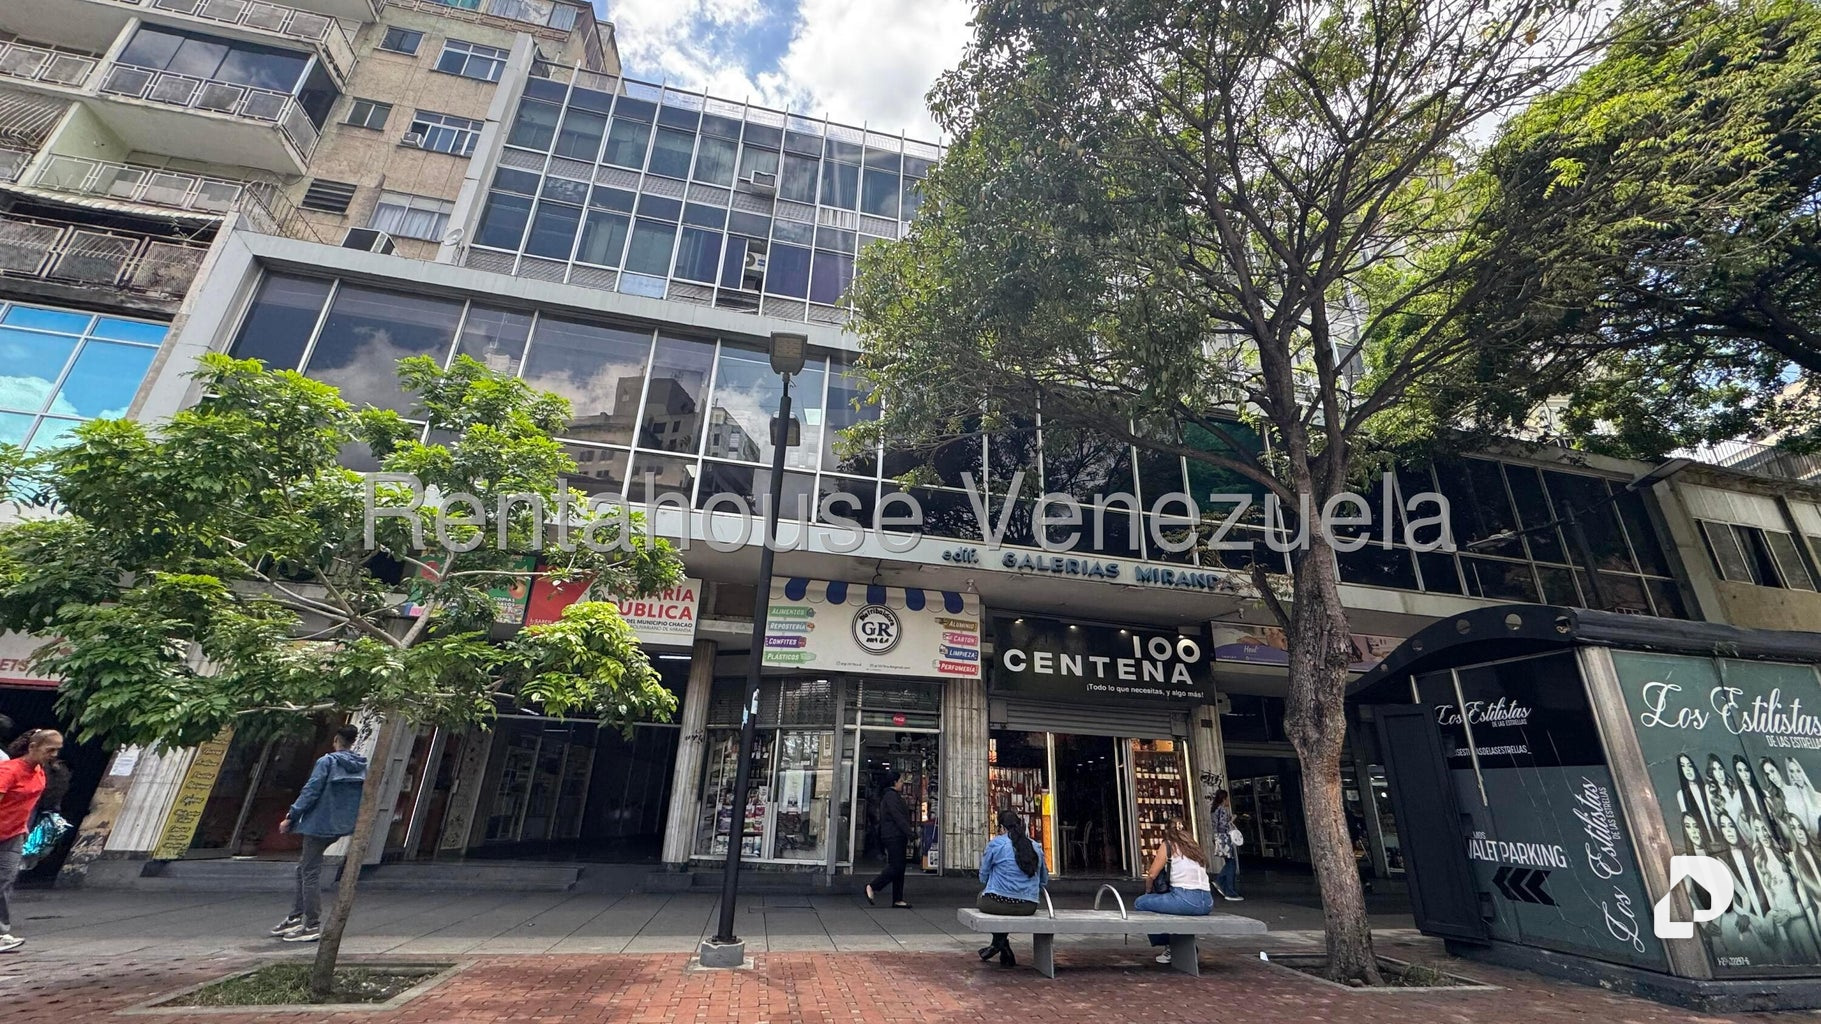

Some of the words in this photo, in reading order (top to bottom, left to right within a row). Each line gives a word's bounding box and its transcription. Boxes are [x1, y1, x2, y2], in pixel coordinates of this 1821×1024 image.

[1001, 551, 1120, 579] GALERIAS
[771, 607, 805, 616] ALIMENTOS
[770, 622, 806, 631] REPOSTERÍA
[861, 621, 894, 637] GR
[768, 637, 798, 646] CONFITES
[766, 652, 800, 660] PLÁSTICOS
[949, 649, 976, 658] LIMPIEZA
[940, 662, 976, 673] PERFUMERÍA
[1003, 648, 1193, 685] CENTENA
[1108, 684, 1115, 692] lo
[1130, 687, 1166, 696] necesitas,
[1171, 690, 1187, 698] algo
[1434, 705, 1463, 726] Los
[1465, 697, 1532, 725] Estilistas
[1640, 681, 1710, 729] Los
[1709, 686, 1821, 735] Estilistas
[1766, 735, 1777, 747] DE
[1776, 735, 1791, 748] LAS
[1598, 786, 1616, 819] ESTRELLAS
[1572, 776, 1623, 879] Estilistas
[1609, 818, 1618, 831] LAS
[1612, 830, 1622, 840] DE
[1498, 841, 1568, 868] PARKING
[1602, 885, 1645, 953] Los
